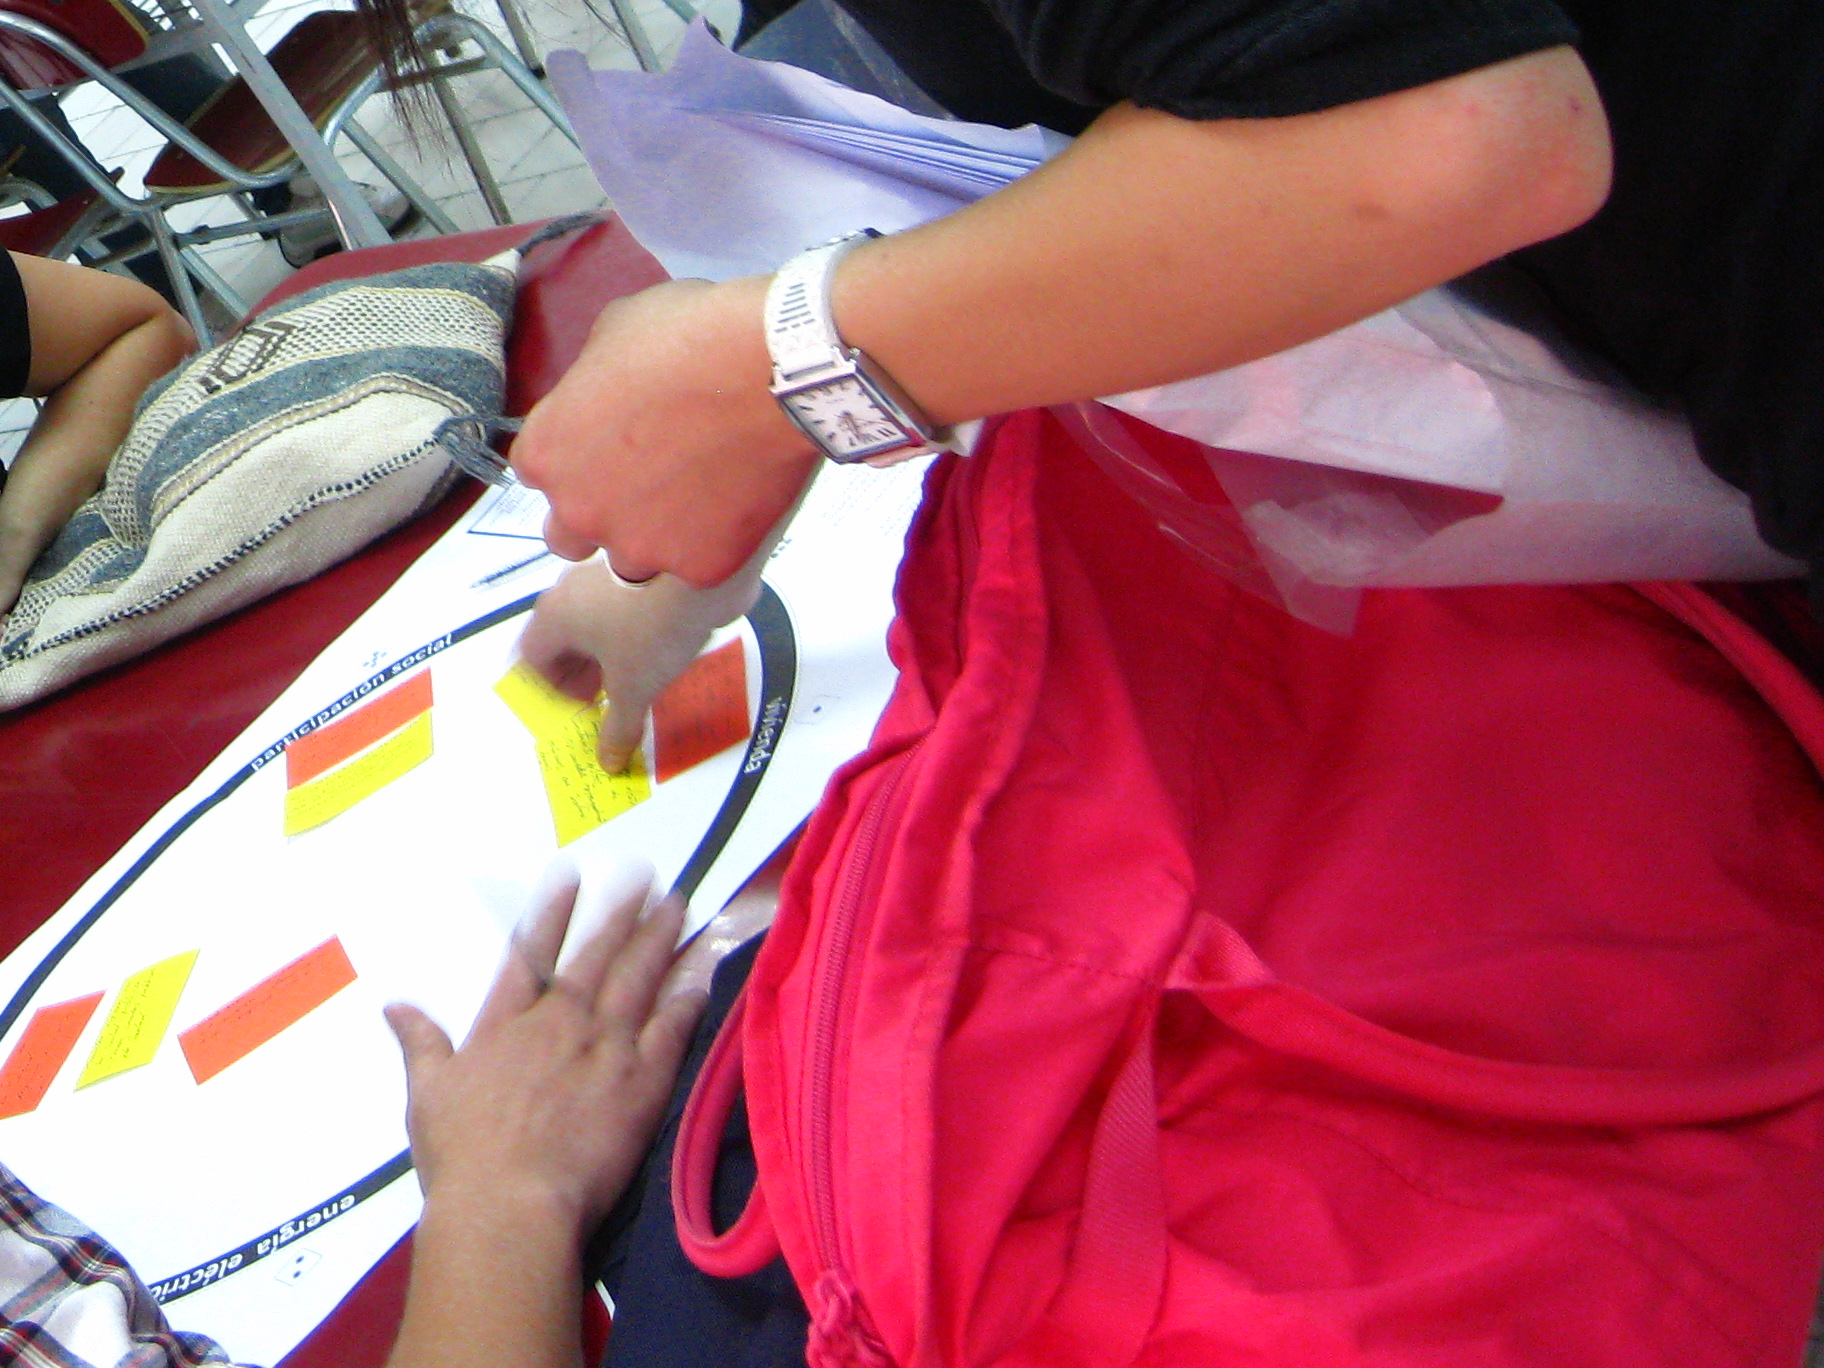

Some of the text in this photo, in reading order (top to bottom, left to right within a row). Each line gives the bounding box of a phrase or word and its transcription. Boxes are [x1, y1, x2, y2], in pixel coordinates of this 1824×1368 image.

[251, 673, 386, 772] participación
[390, 632, 453, 676] social
[743, 696, 788, 774] vivienda
[150, 1194, 356, 1302] energía eléctric
